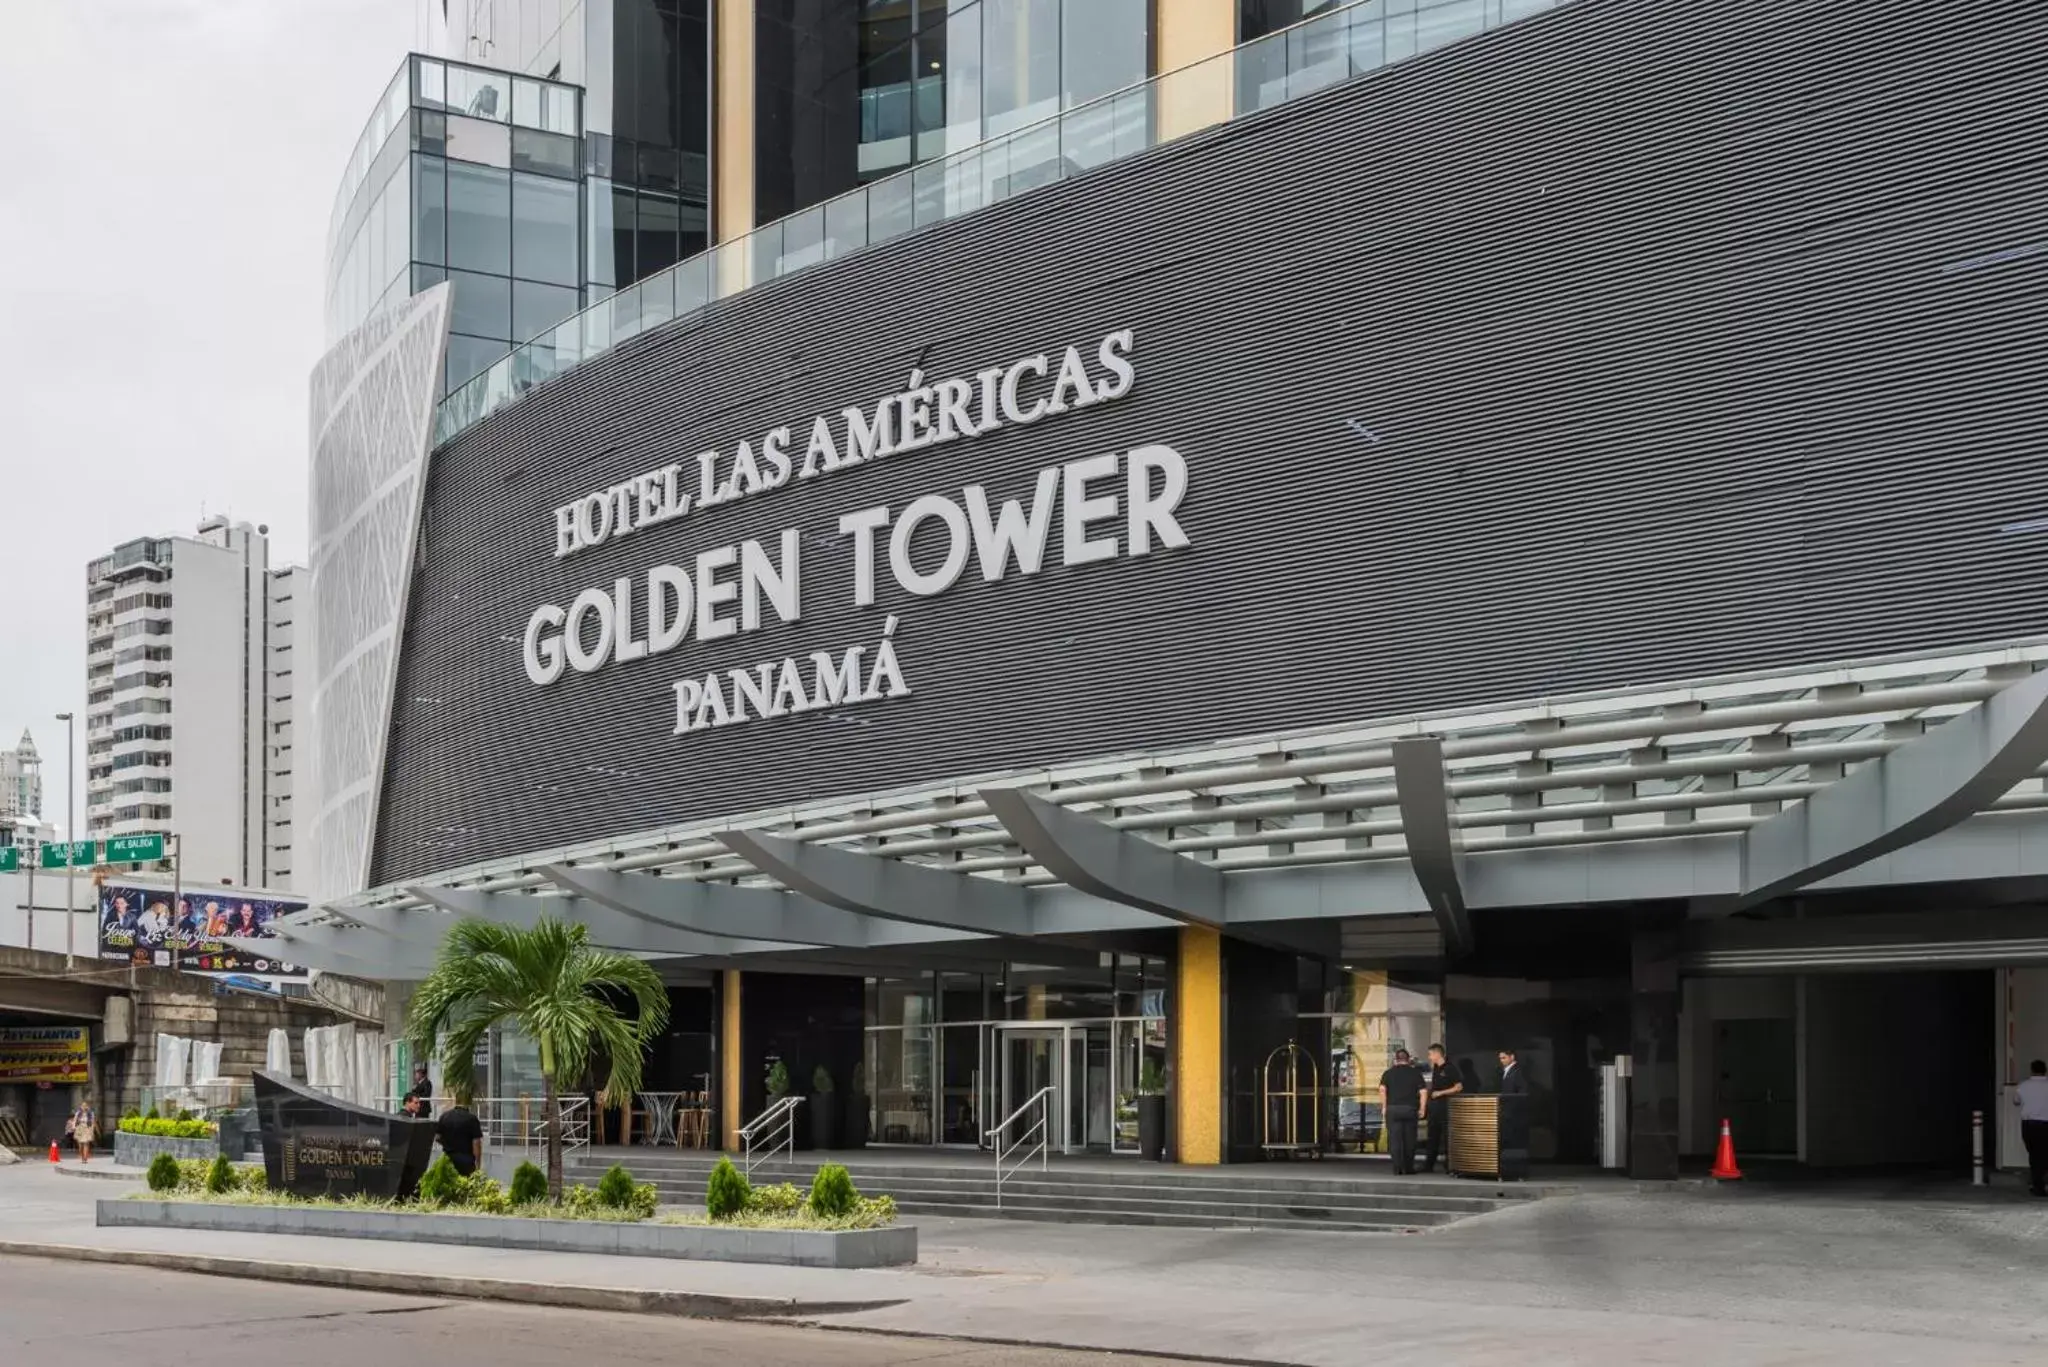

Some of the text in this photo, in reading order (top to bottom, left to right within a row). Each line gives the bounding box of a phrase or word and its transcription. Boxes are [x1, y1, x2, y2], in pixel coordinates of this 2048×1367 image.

[554, 329, 1134, 557] HOTEL LAS AMÉRICAS
[523, 445, 1191, 686] GOLDEN TOWER
[672, 614, 912, 734] PANAMÁ
[128, 838, 153, 849] BALBOA
[299, 1148, 384, 1166] GOLDEN TOWER
